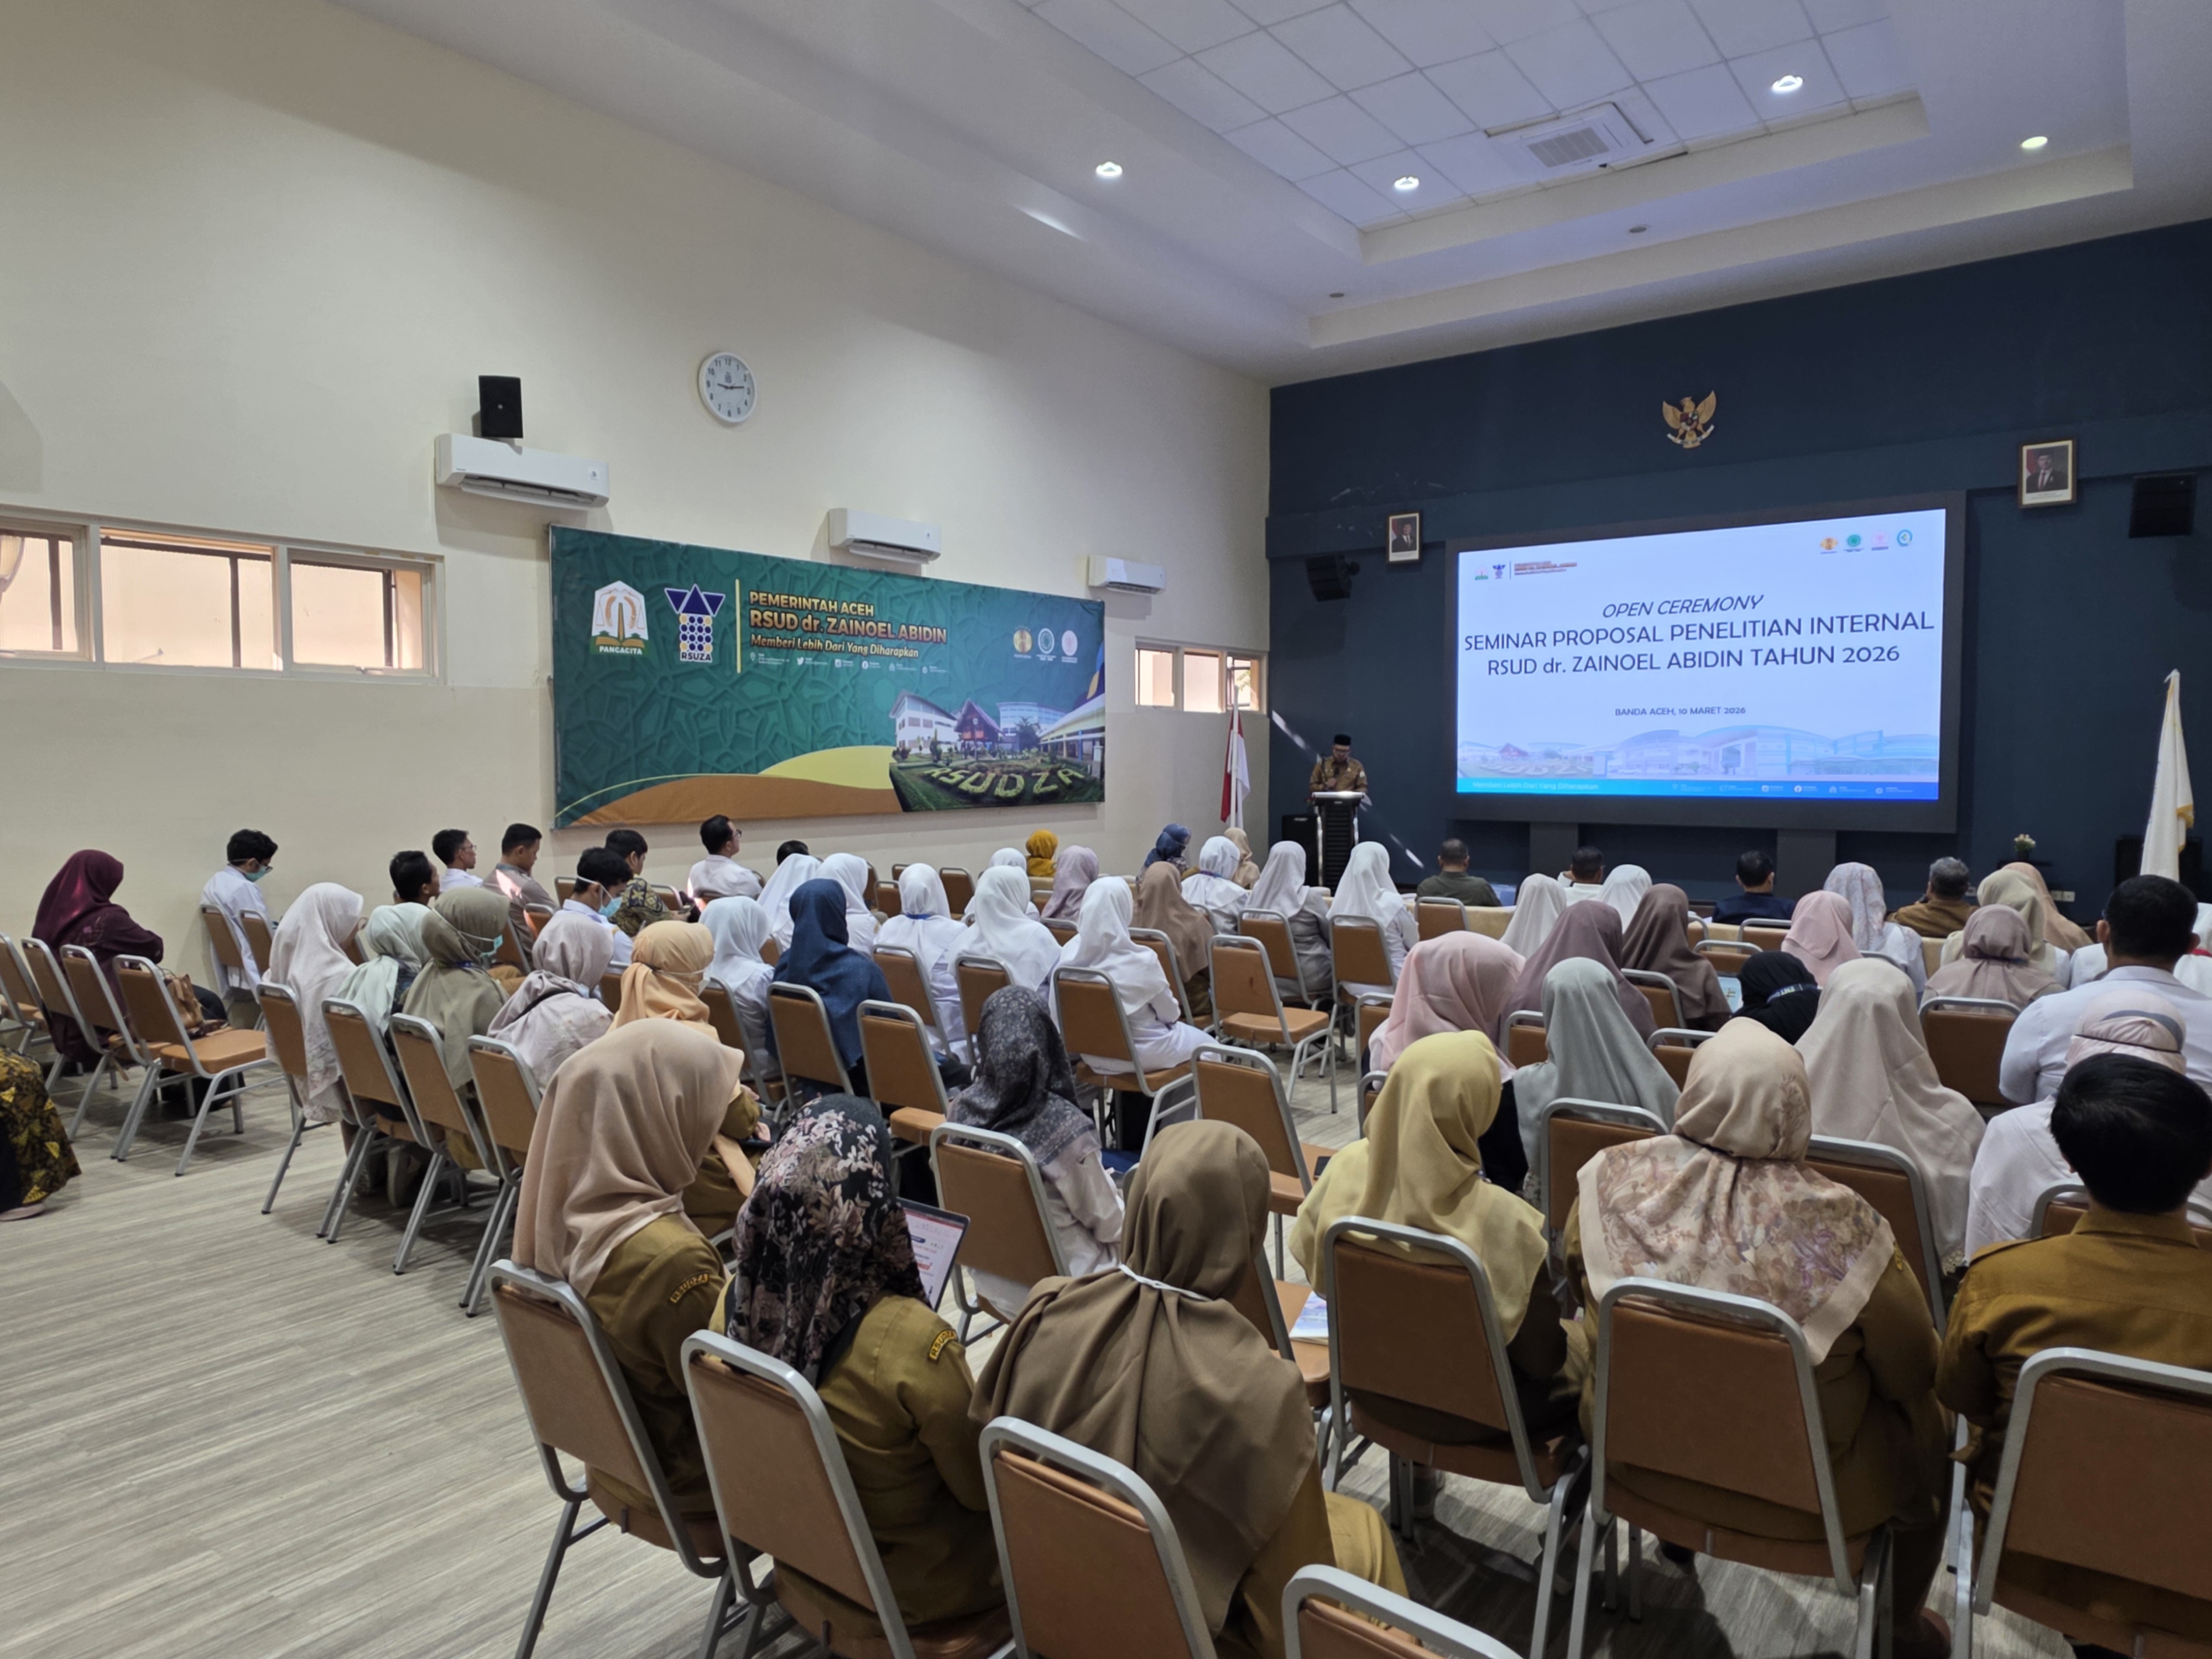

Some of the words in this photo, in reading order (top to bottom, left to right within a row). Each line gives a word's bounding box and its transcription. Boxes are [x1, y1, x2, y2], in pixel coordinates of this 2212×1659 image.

[715, 359, 721, 367] 11
[724, 358, 732, 366] 12
[708, 367, 714, 375] 10
[750, 591, 838, 613] PEMERINTAH
[841, 602, 874, 617] ACEH
[1603, 601, 1653, 618] OPEN
[1657, 594, 1764, 615] CEREMONY
[750, 609, 799, 630] RSUD
[802, 614, 823, 632] dr.
[827, 617, 896, 639] ZAINOEL
[898, 624, 947, 643] ABIDIN
[1464, 632, 1547, 651] SEMINAR
[1553, 626, 1664, 647] PROPOSAL
[1671, 617, 1802, 641] PENELITIAN
[1811, 611, 1935, 635] INTERNAL
[599, 646, 642, 655] PANCACITA
[751, 634, 796, 648] Memberi
[797, 638, 823, 651] Lebih
[825, 640, 844, 652] Dari
[847, 642, 868, 656] Yang
[870, 644, 919, 658] Diharapkan
[681, 652, 711, 661] RSUZA
[1488, 659, 1537, 676] RSUD
[1542, 658, 1566, 674] dr.
[1572, 653, 1661, 673] ZAINOEL
[1667, 649, 1743, 670] ABIDIN
[1750, 646, 1835, 666] TAHUN
[1842, 645, 1900, 664] 2026
[1615, 708, 1647, 716] BANDA
[1649, 707, 1676, 716] ACEH,
[1690, 706, 1721, 715] MARET
